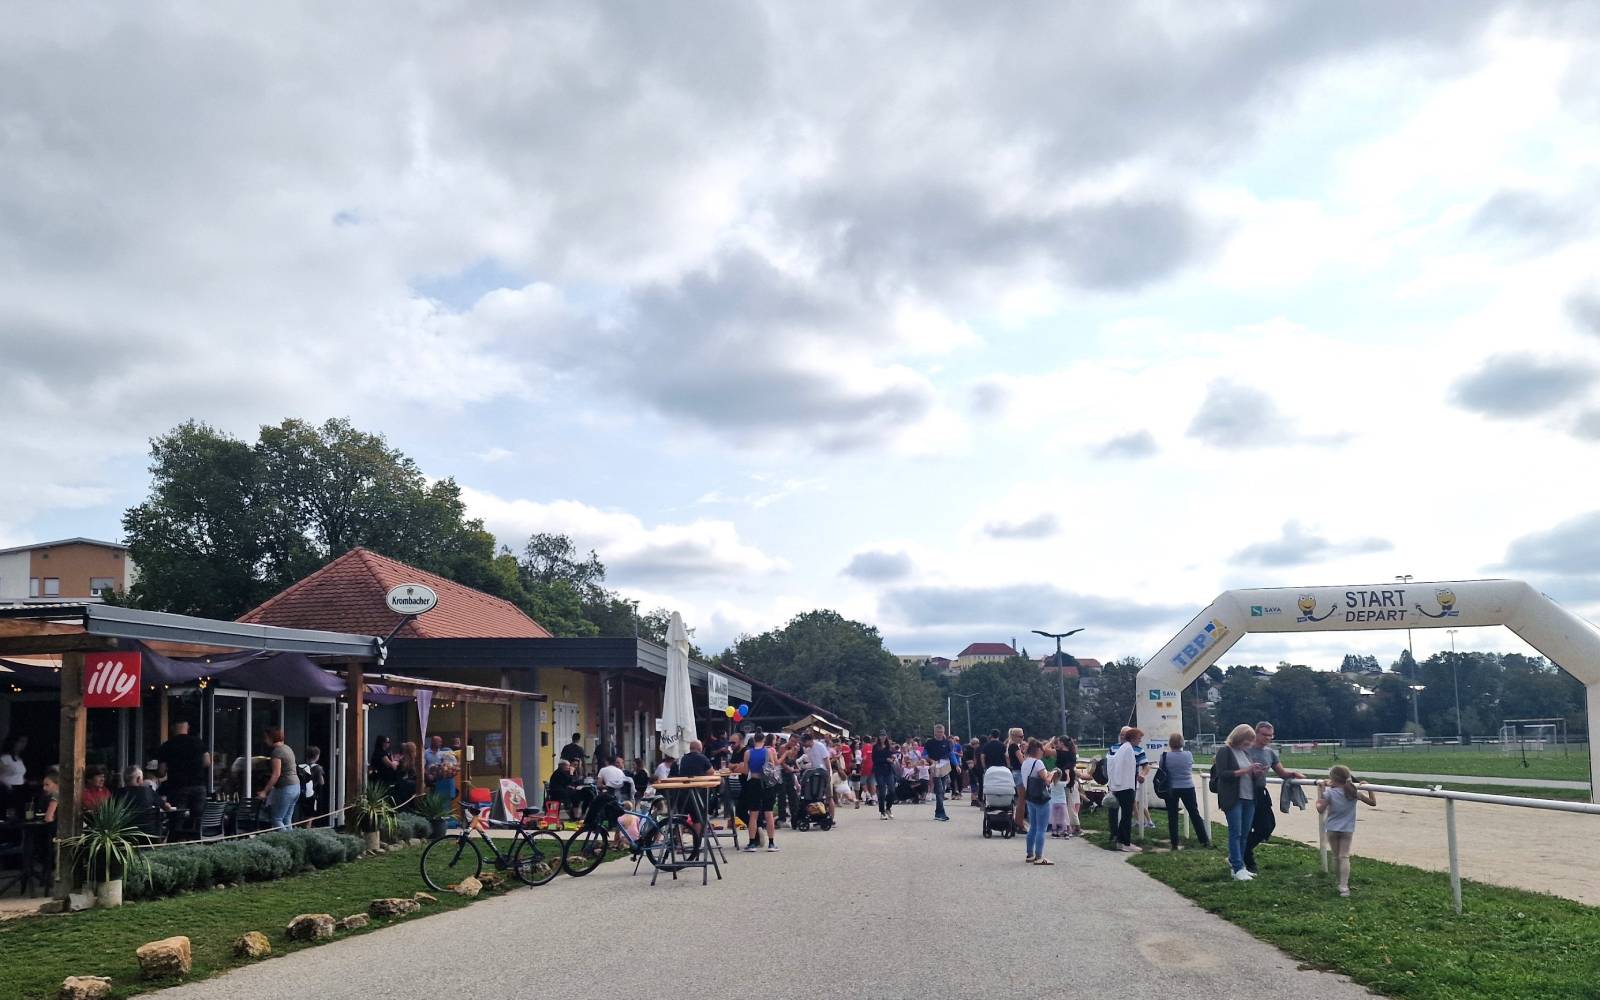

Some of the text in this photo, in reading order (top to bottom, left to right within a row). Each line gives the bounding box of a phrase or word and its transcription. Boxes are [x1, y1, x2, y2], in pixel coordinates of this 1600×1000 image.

[392, 596, 430, 605] Krombacher
[1345, 590, 1406, 608] START
[1345, 610, 1408, 622] DEPART
[1172, 633, 1207, 667] TBP
[87, 660, 137, 702] illy
